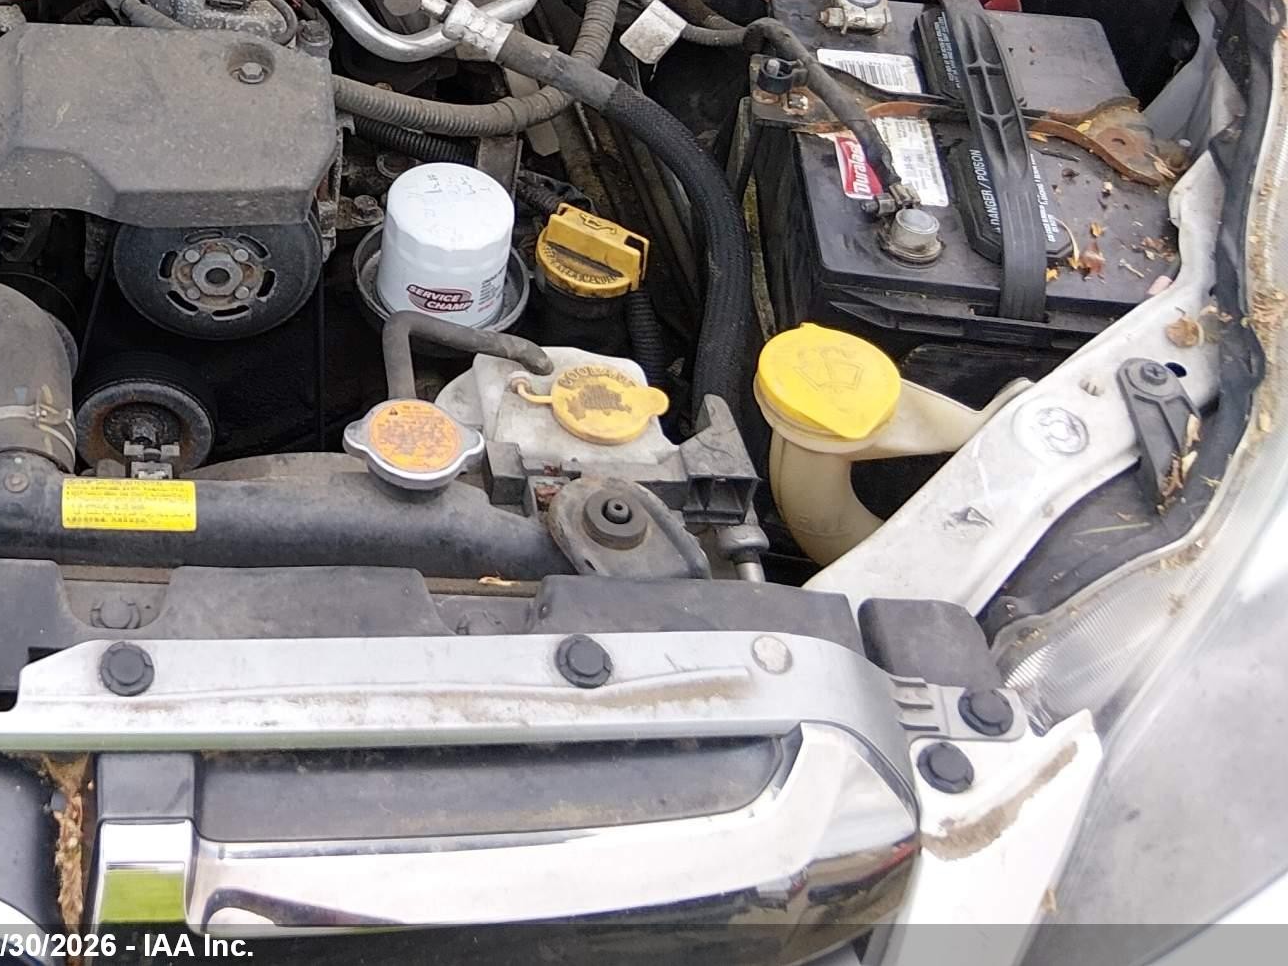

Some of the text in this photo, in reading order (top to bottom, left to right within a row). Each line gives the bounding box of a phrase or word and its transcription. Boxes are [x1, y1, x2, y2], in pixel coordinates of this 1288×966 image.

[968, 149, 990, 182] POISON
[980, 189, 1000, 226] DANGER
[408, 285, 461, 302] SERVICE
[426, 301, 472, 311] CHAMP
